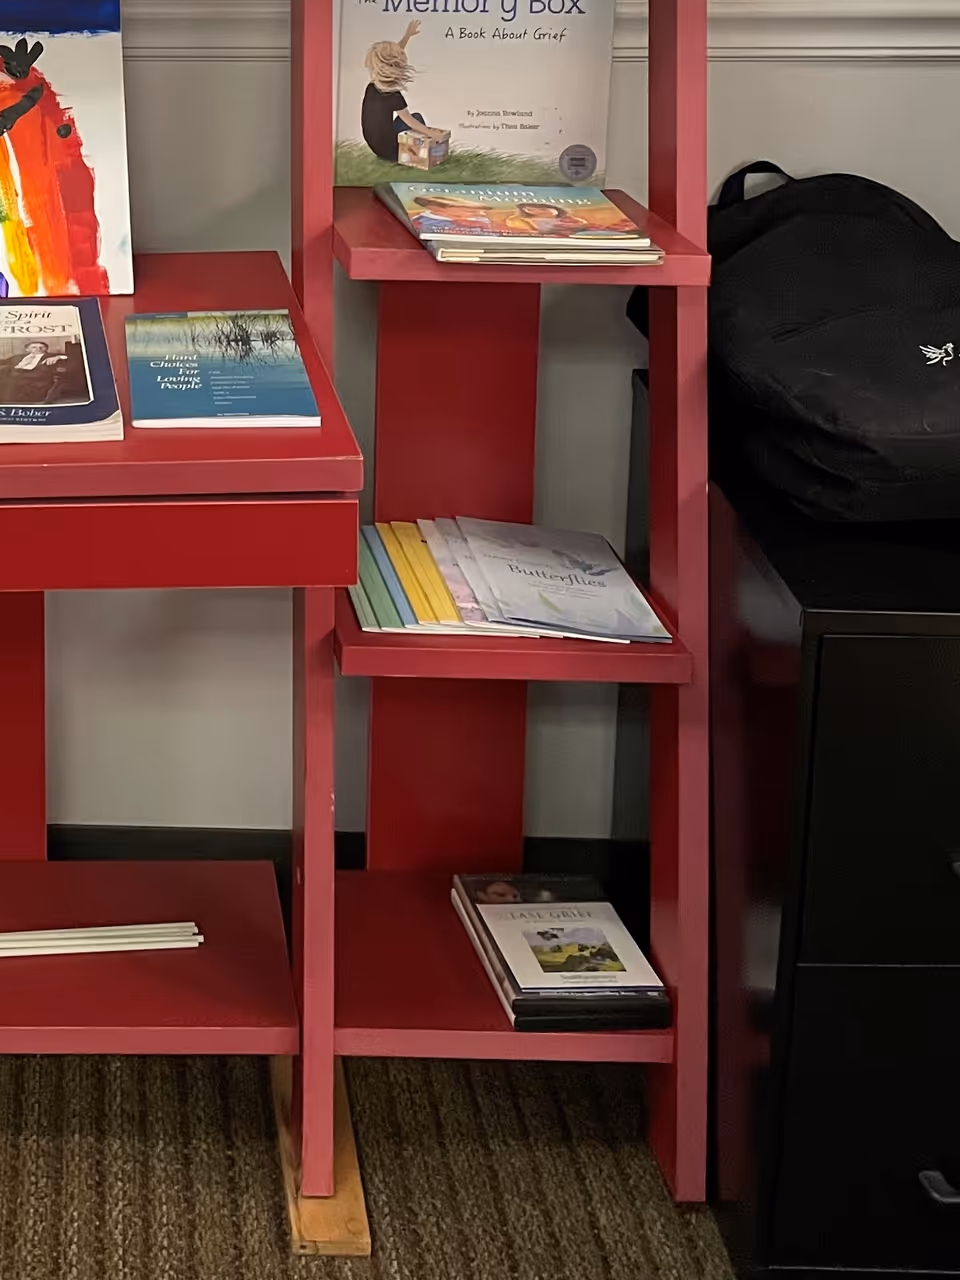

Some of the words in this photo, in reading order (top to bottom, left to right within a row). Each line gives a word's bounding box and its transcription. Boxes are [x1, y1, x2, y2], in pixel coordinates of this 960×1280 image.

[445, 26, 455, 39] A
[459, 26, 487, 40] Book
[492, 27, 528, 40] About
[533, 27, 568, 43] Grief
[408, 184, 535, 197] Geranium
[478, 195, 592, 206] Morning
[5, 310, 53, 321] Spirit
[156, 375, 201, 383] Loving
[160, 382, 203, 391] People
[10, 408, 52, 417] Bober
[506, 562, 607, 588] Butterflies
